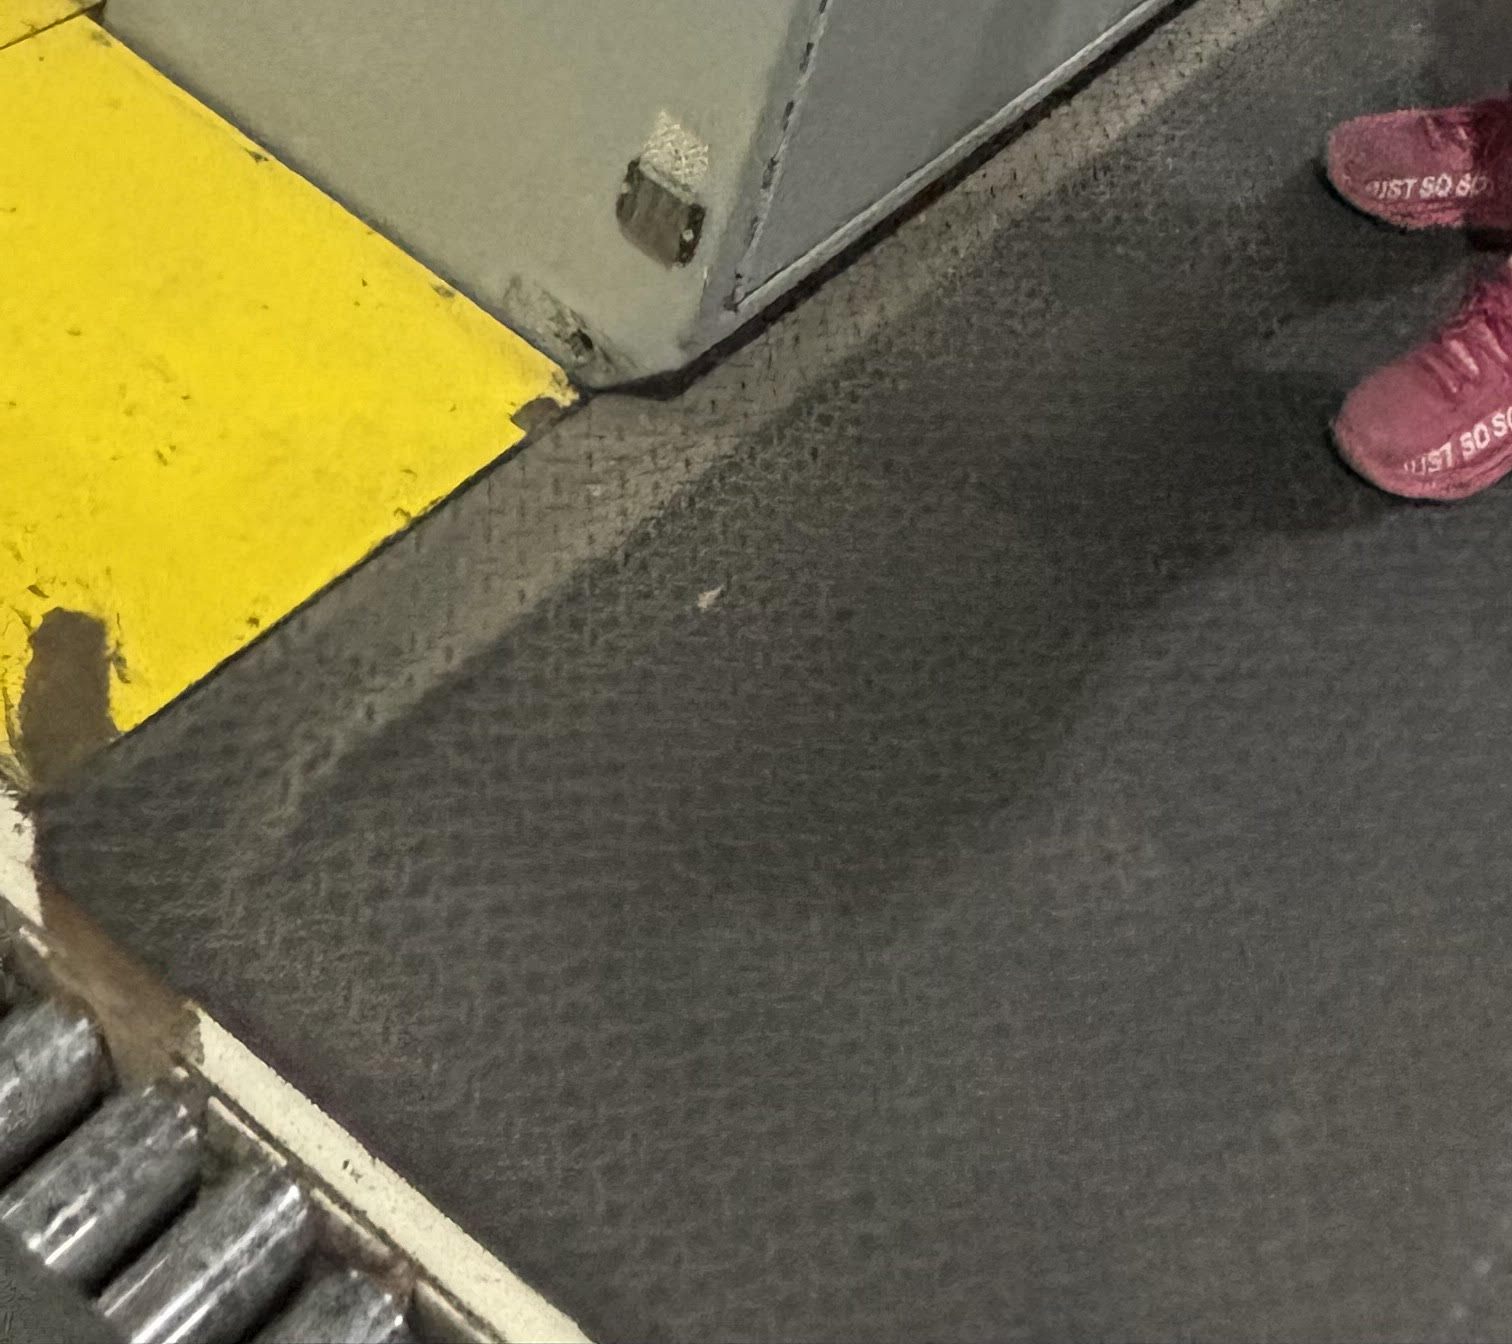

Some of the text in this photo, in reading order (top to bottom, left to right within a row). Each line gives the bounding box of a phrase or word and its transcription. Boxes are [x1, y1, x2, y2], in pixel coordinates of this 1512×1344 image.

[1419, 172, 1453, 199] SO
[1403, 441, 1454, 477] UST
[1459, 421, 1491, 461] SO
